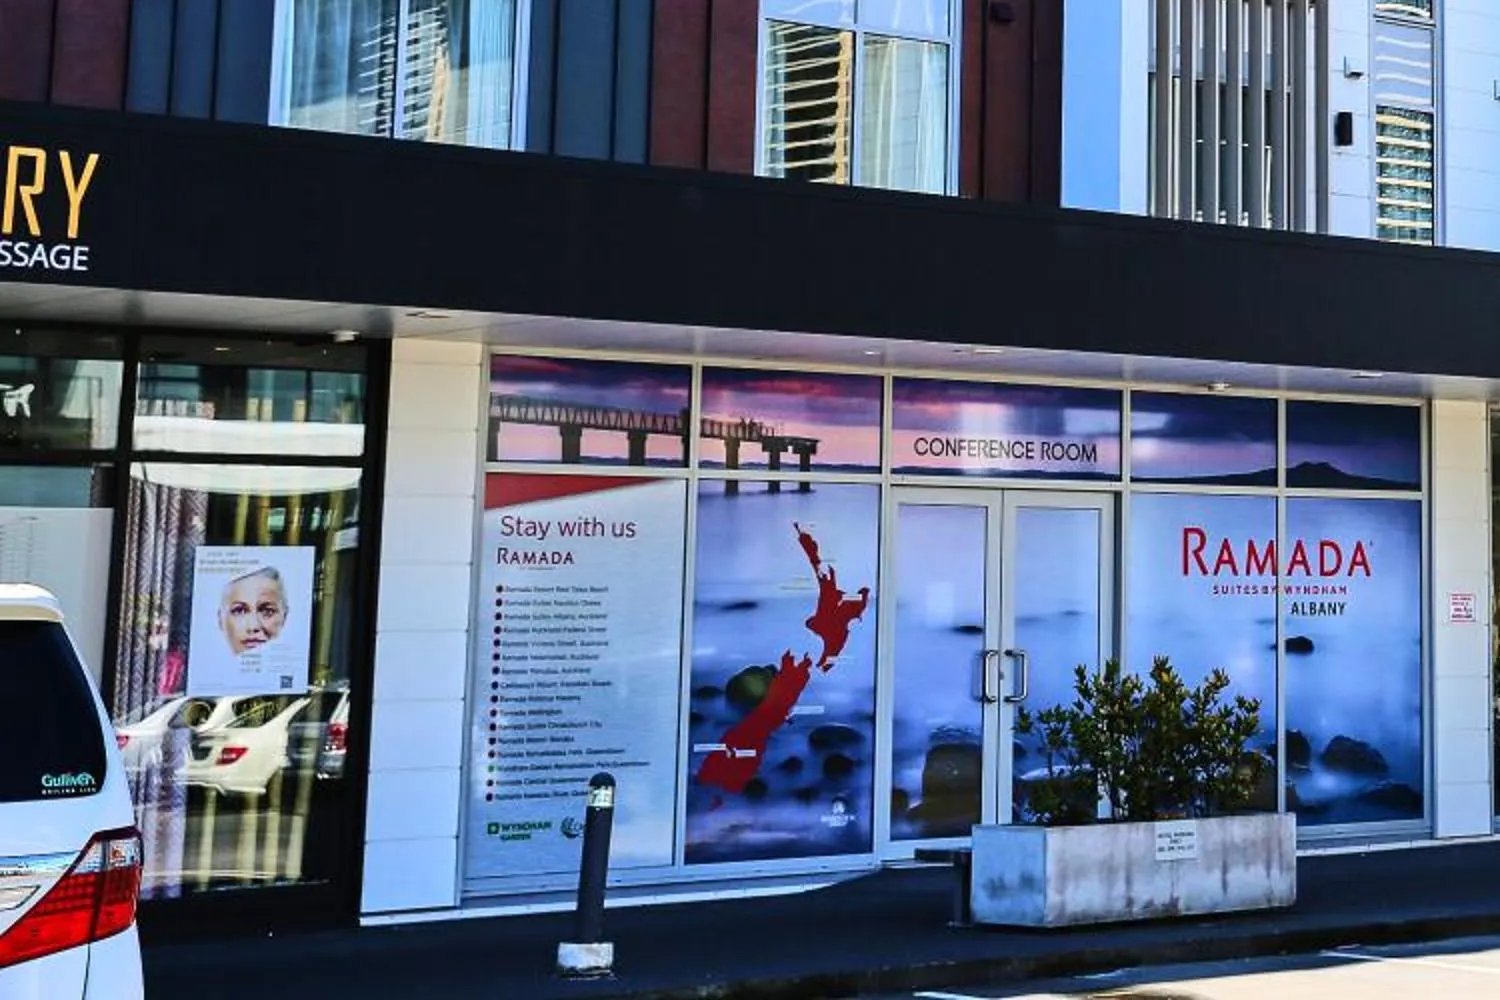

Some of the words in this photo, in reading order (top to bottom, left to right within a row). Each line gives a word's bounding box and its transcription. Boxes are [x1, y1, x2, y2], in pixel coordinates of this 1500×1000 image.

[2, 145, 100, 239] RY
[0, 240, 90, 271] SSAGE
[913, 436, 1035, 459] CONFERENCE
[1040, 441, 1098, 462] ROOM
[500, 515, 551, 541] Stay
[557, 516, 605, 537] with
[611, 521, 638, 539] us
[496, 547, 575, 565] RAMADA
[1182, 526, 1372, 577] RAMADA
[1284, 584, 1348, 596] WYNDHAM
[1290, 601, 1346, 617] ALBANY
